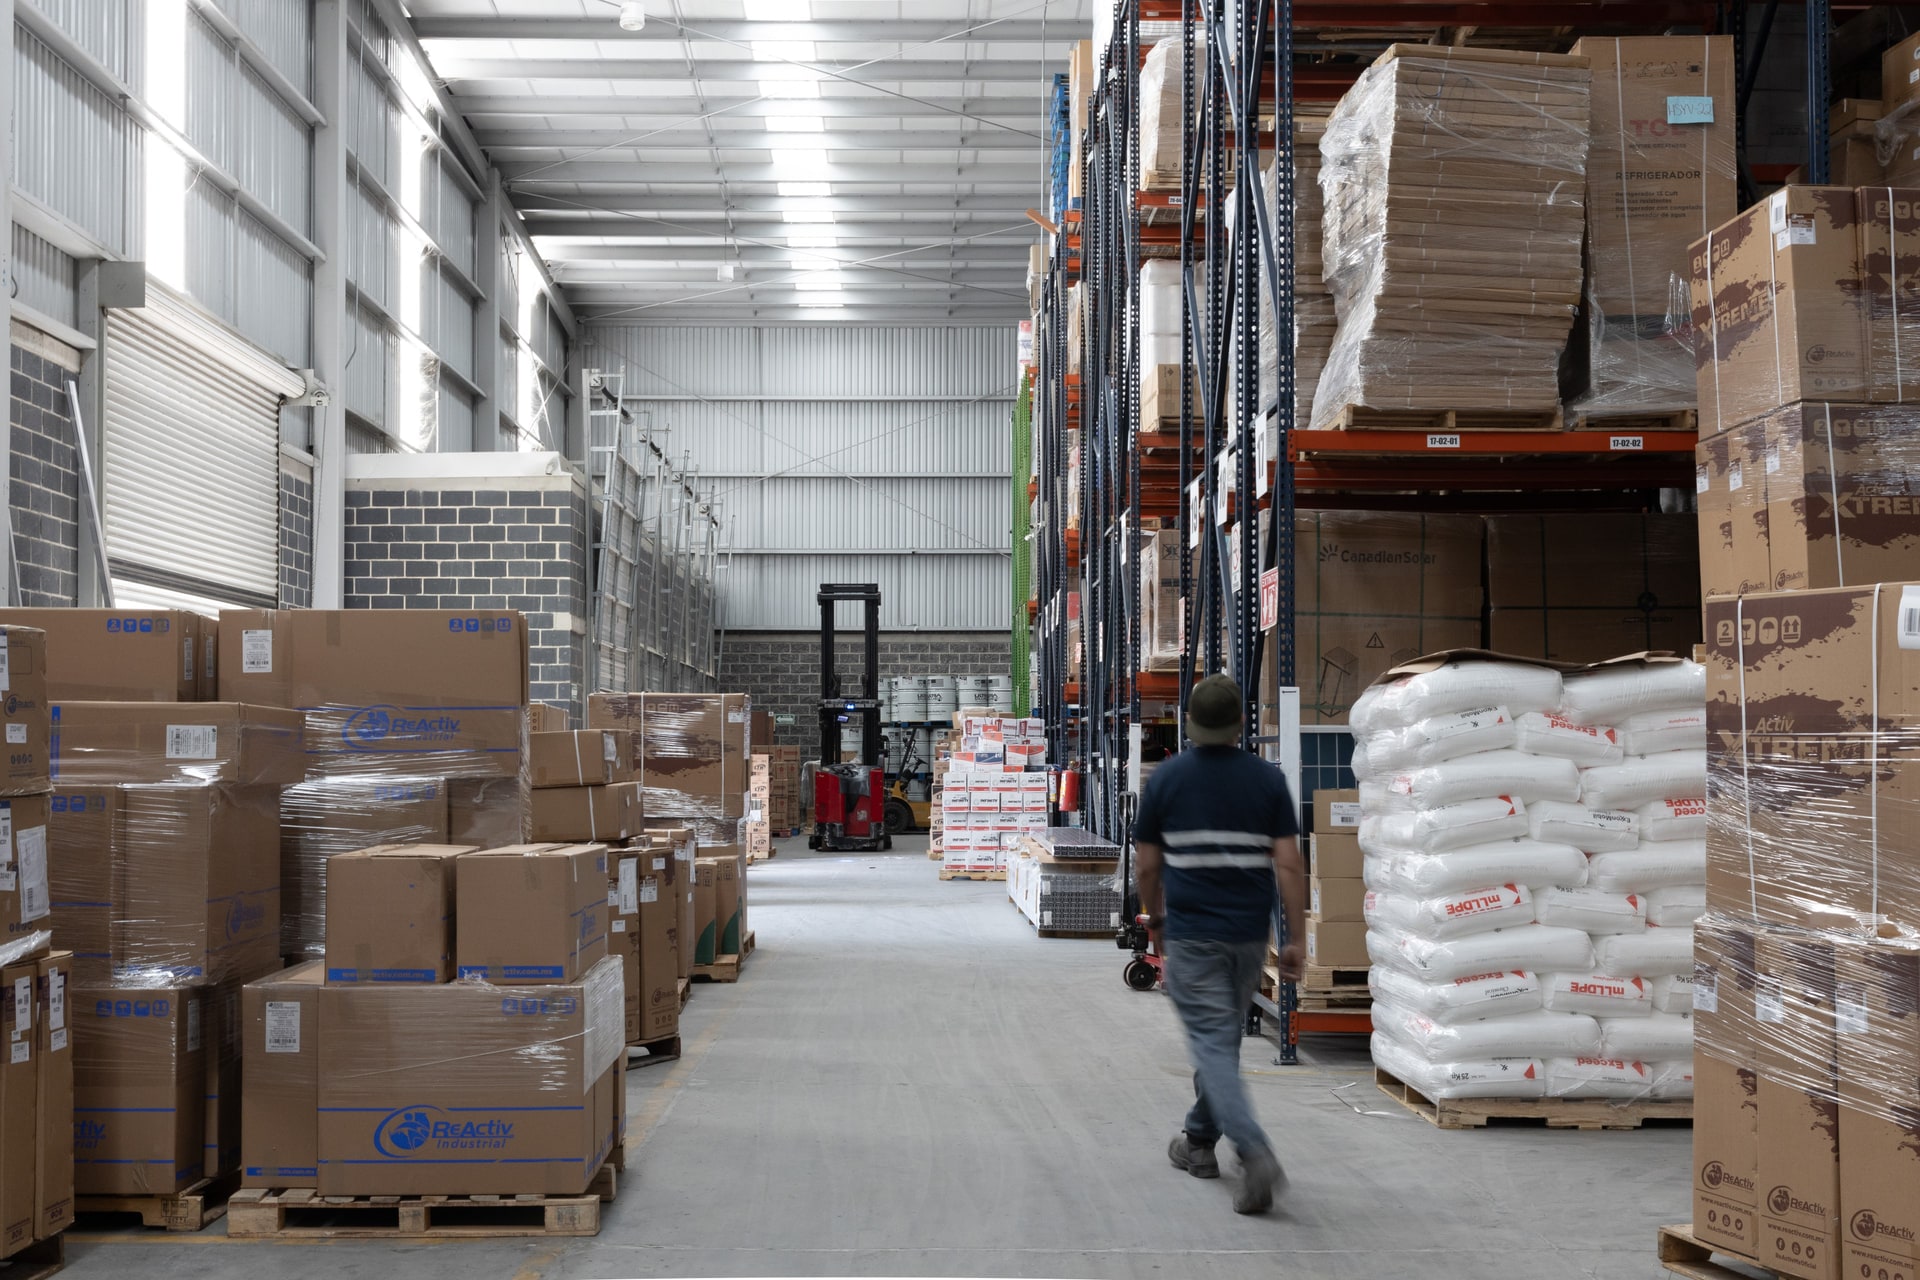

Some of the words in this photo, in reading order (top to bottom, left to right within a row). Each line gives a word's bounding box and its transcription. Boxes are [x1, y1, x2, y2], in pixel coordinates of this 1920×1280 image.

[1616, 170, 1701, 180] REFRIGERADOR
[1430, 437, 1458, 445] 17-02-01
[1612, 439, 1641, 447] 17-02-02
[1550, 719, 1598, 737] Exceed
[1754, 716, 1795, 732] Activ
[1674, 807, 1705, 817] ceed
[1445, 894, 1502, 915] mLLDPE
[1570, 982, 1625, 996] mLLDPE
[1577, 1056, 1625, 1070] Exceed
[432, 1120, 514, 1138] ReActiv
[436, 1139, 507, 1149] Industrial
[1723, 1172, 1754, 1189] ReActiv
[1790, 1197, 1825, 1215] ReActiv
[1768, 1222, 1824, 1243] www.reactiv.com.mx
[1875, 1222, 1915, 1239] ReActiv
[1851, 1249, 1914, 1270] www.reactiv.com.mx
